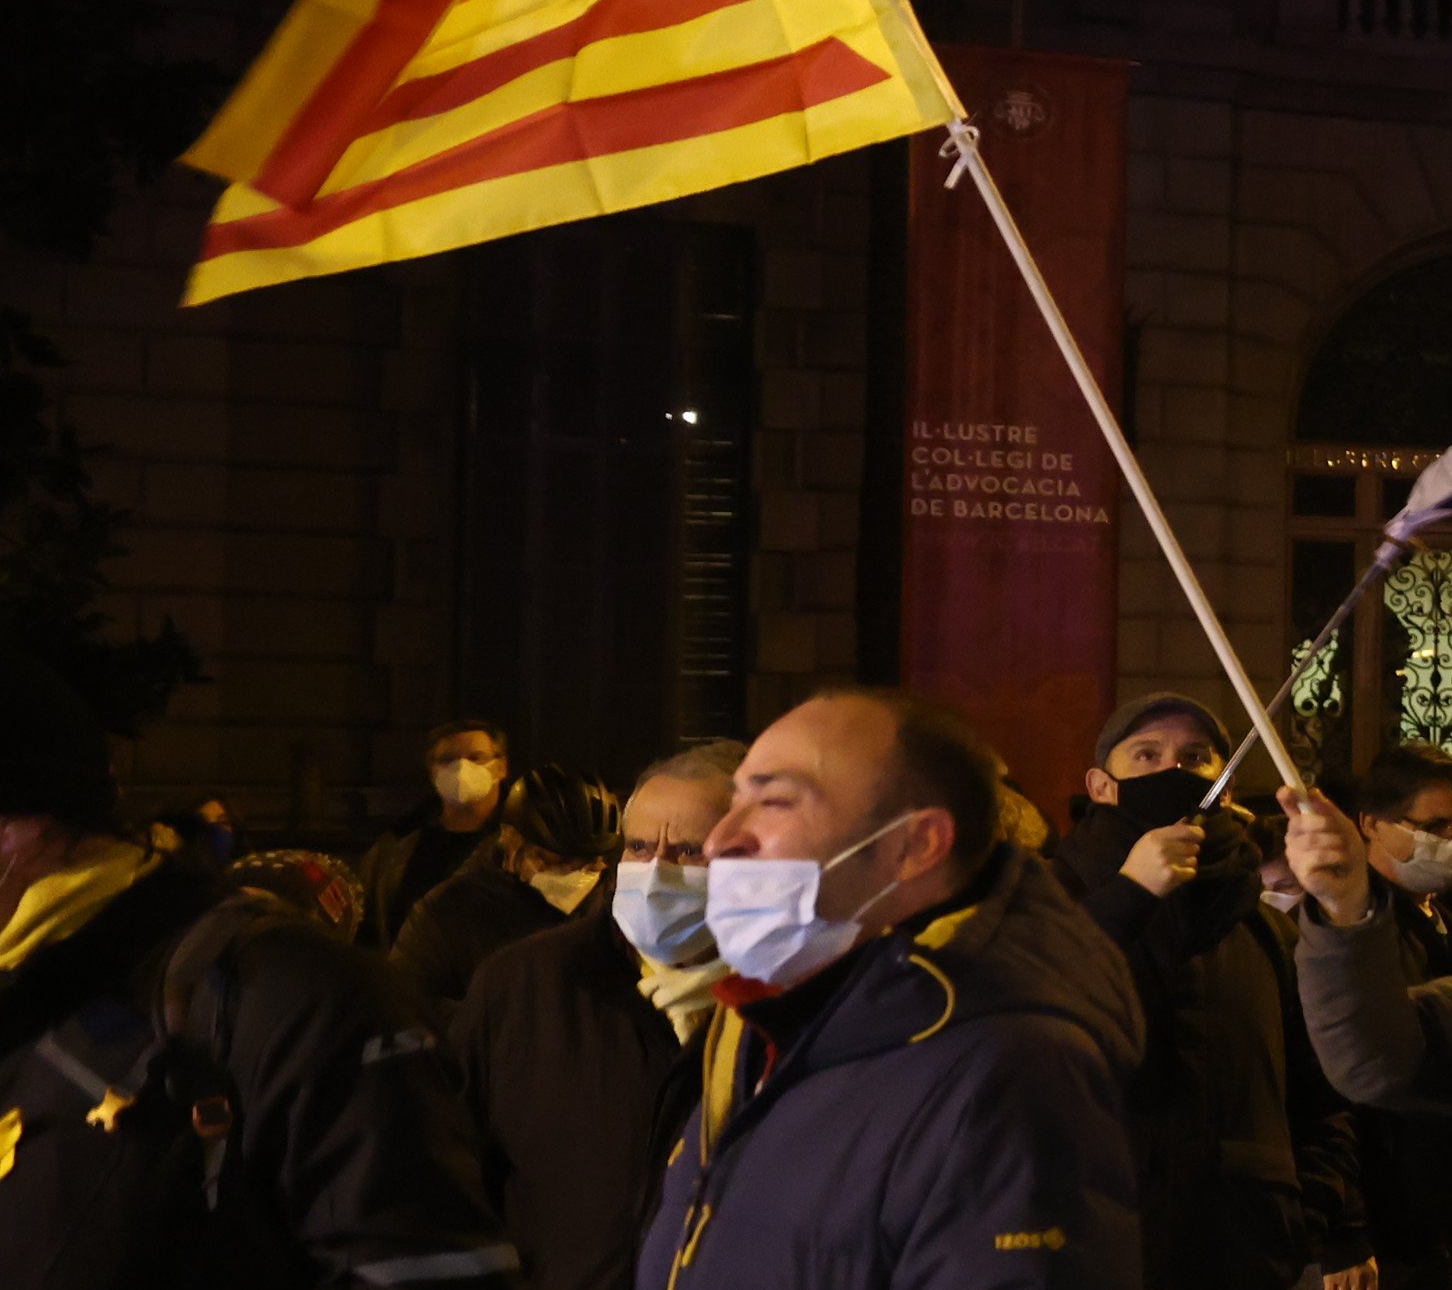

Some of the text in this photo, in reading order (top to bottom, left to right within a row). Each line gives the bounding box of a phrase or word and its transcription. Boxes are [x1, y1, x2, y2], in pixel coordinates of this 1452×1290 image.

[1042, 453, 1073, 471] DE
[911, 469, 1081, 496] L'ADVOCACIA
[910, 498, 1111, 523] DE BARCELONA
